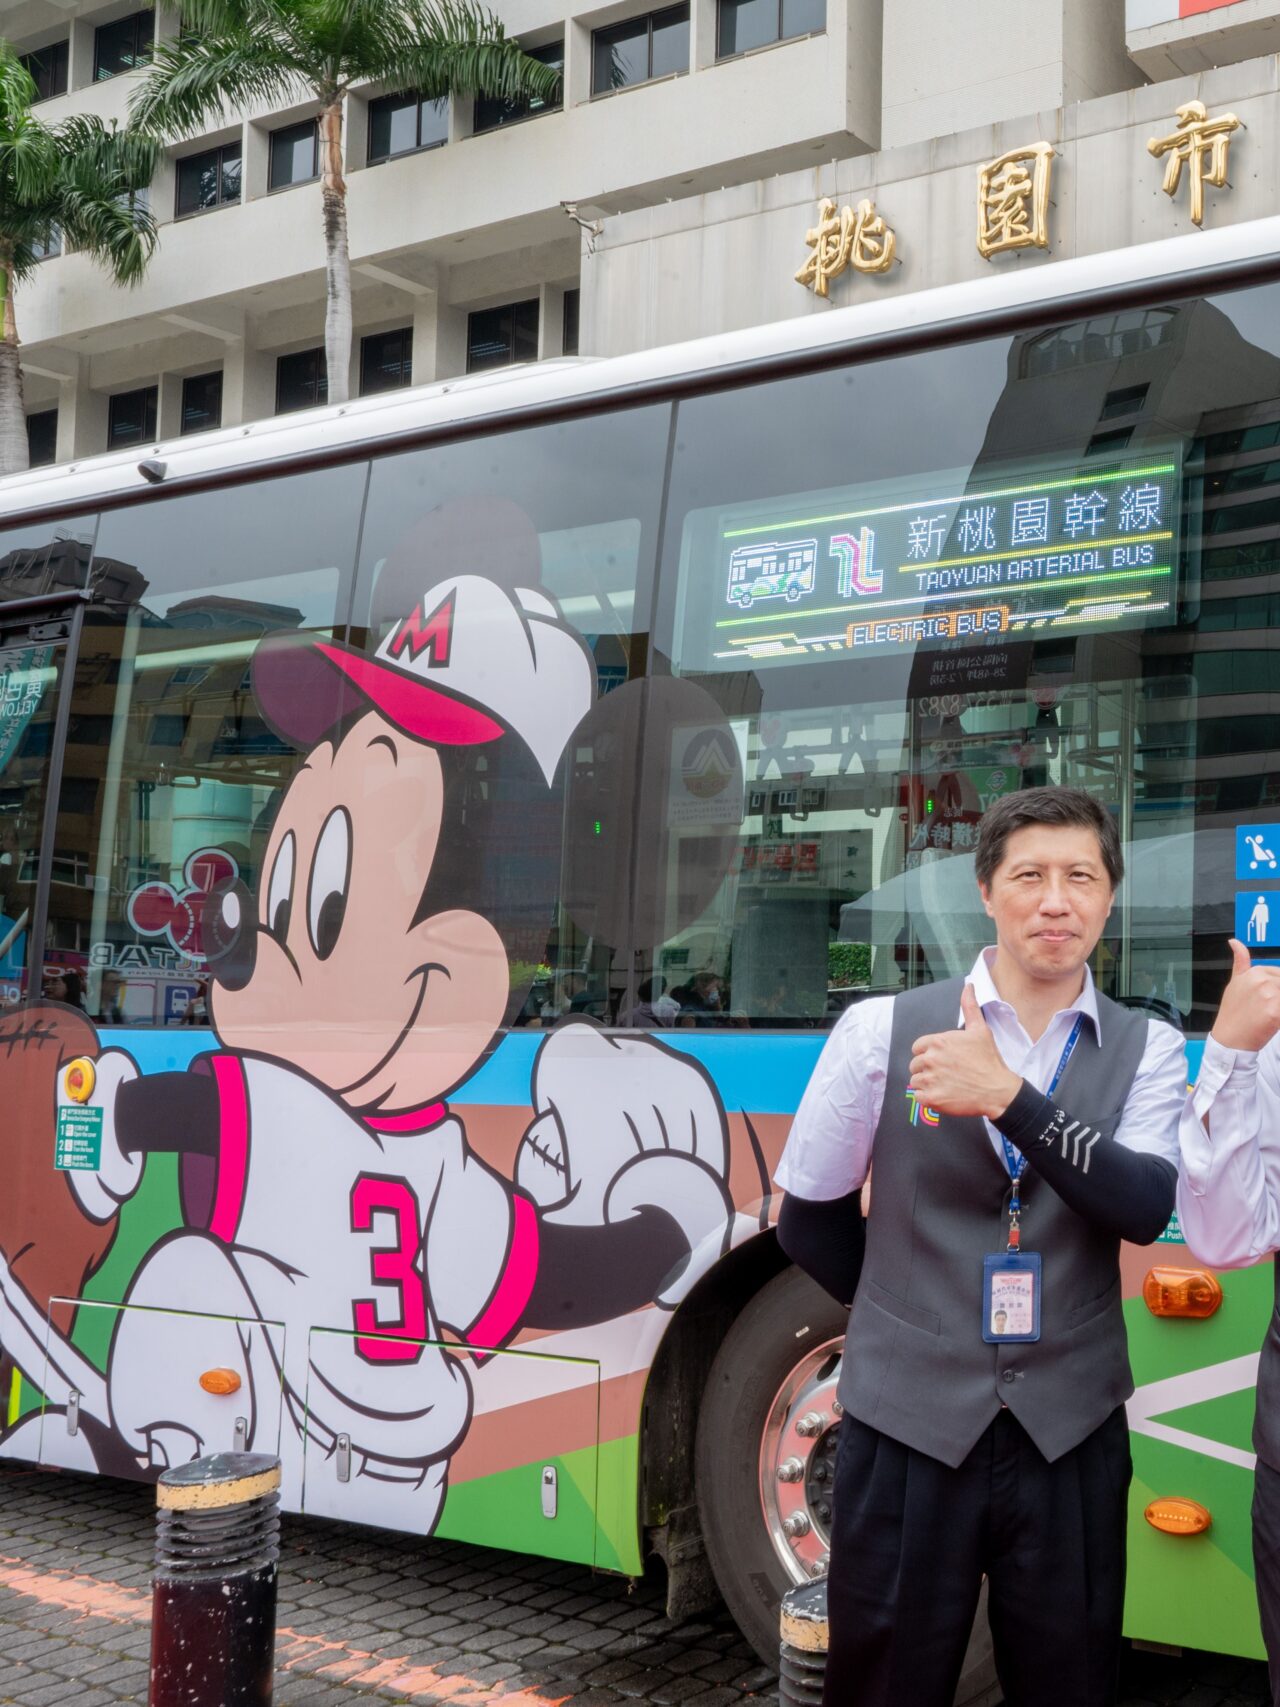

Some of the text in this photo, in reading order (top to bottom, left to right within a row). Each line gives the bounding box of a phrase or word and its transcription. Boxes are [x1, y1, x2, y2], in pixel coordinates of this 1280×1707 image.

[906, 482, 1162, 560] 新桃園幹線
[915, 544, 1154, 592] TAOYUAN ARTERIAL BUS
[387, 586, 457, 669] M
[852, 617, 950, 647] ELECTRIC
[956, 611, 1002, 636] BUS
[1167, 1231, 1183, 1240] Push
[351, 1170, 430, 1366] 3
